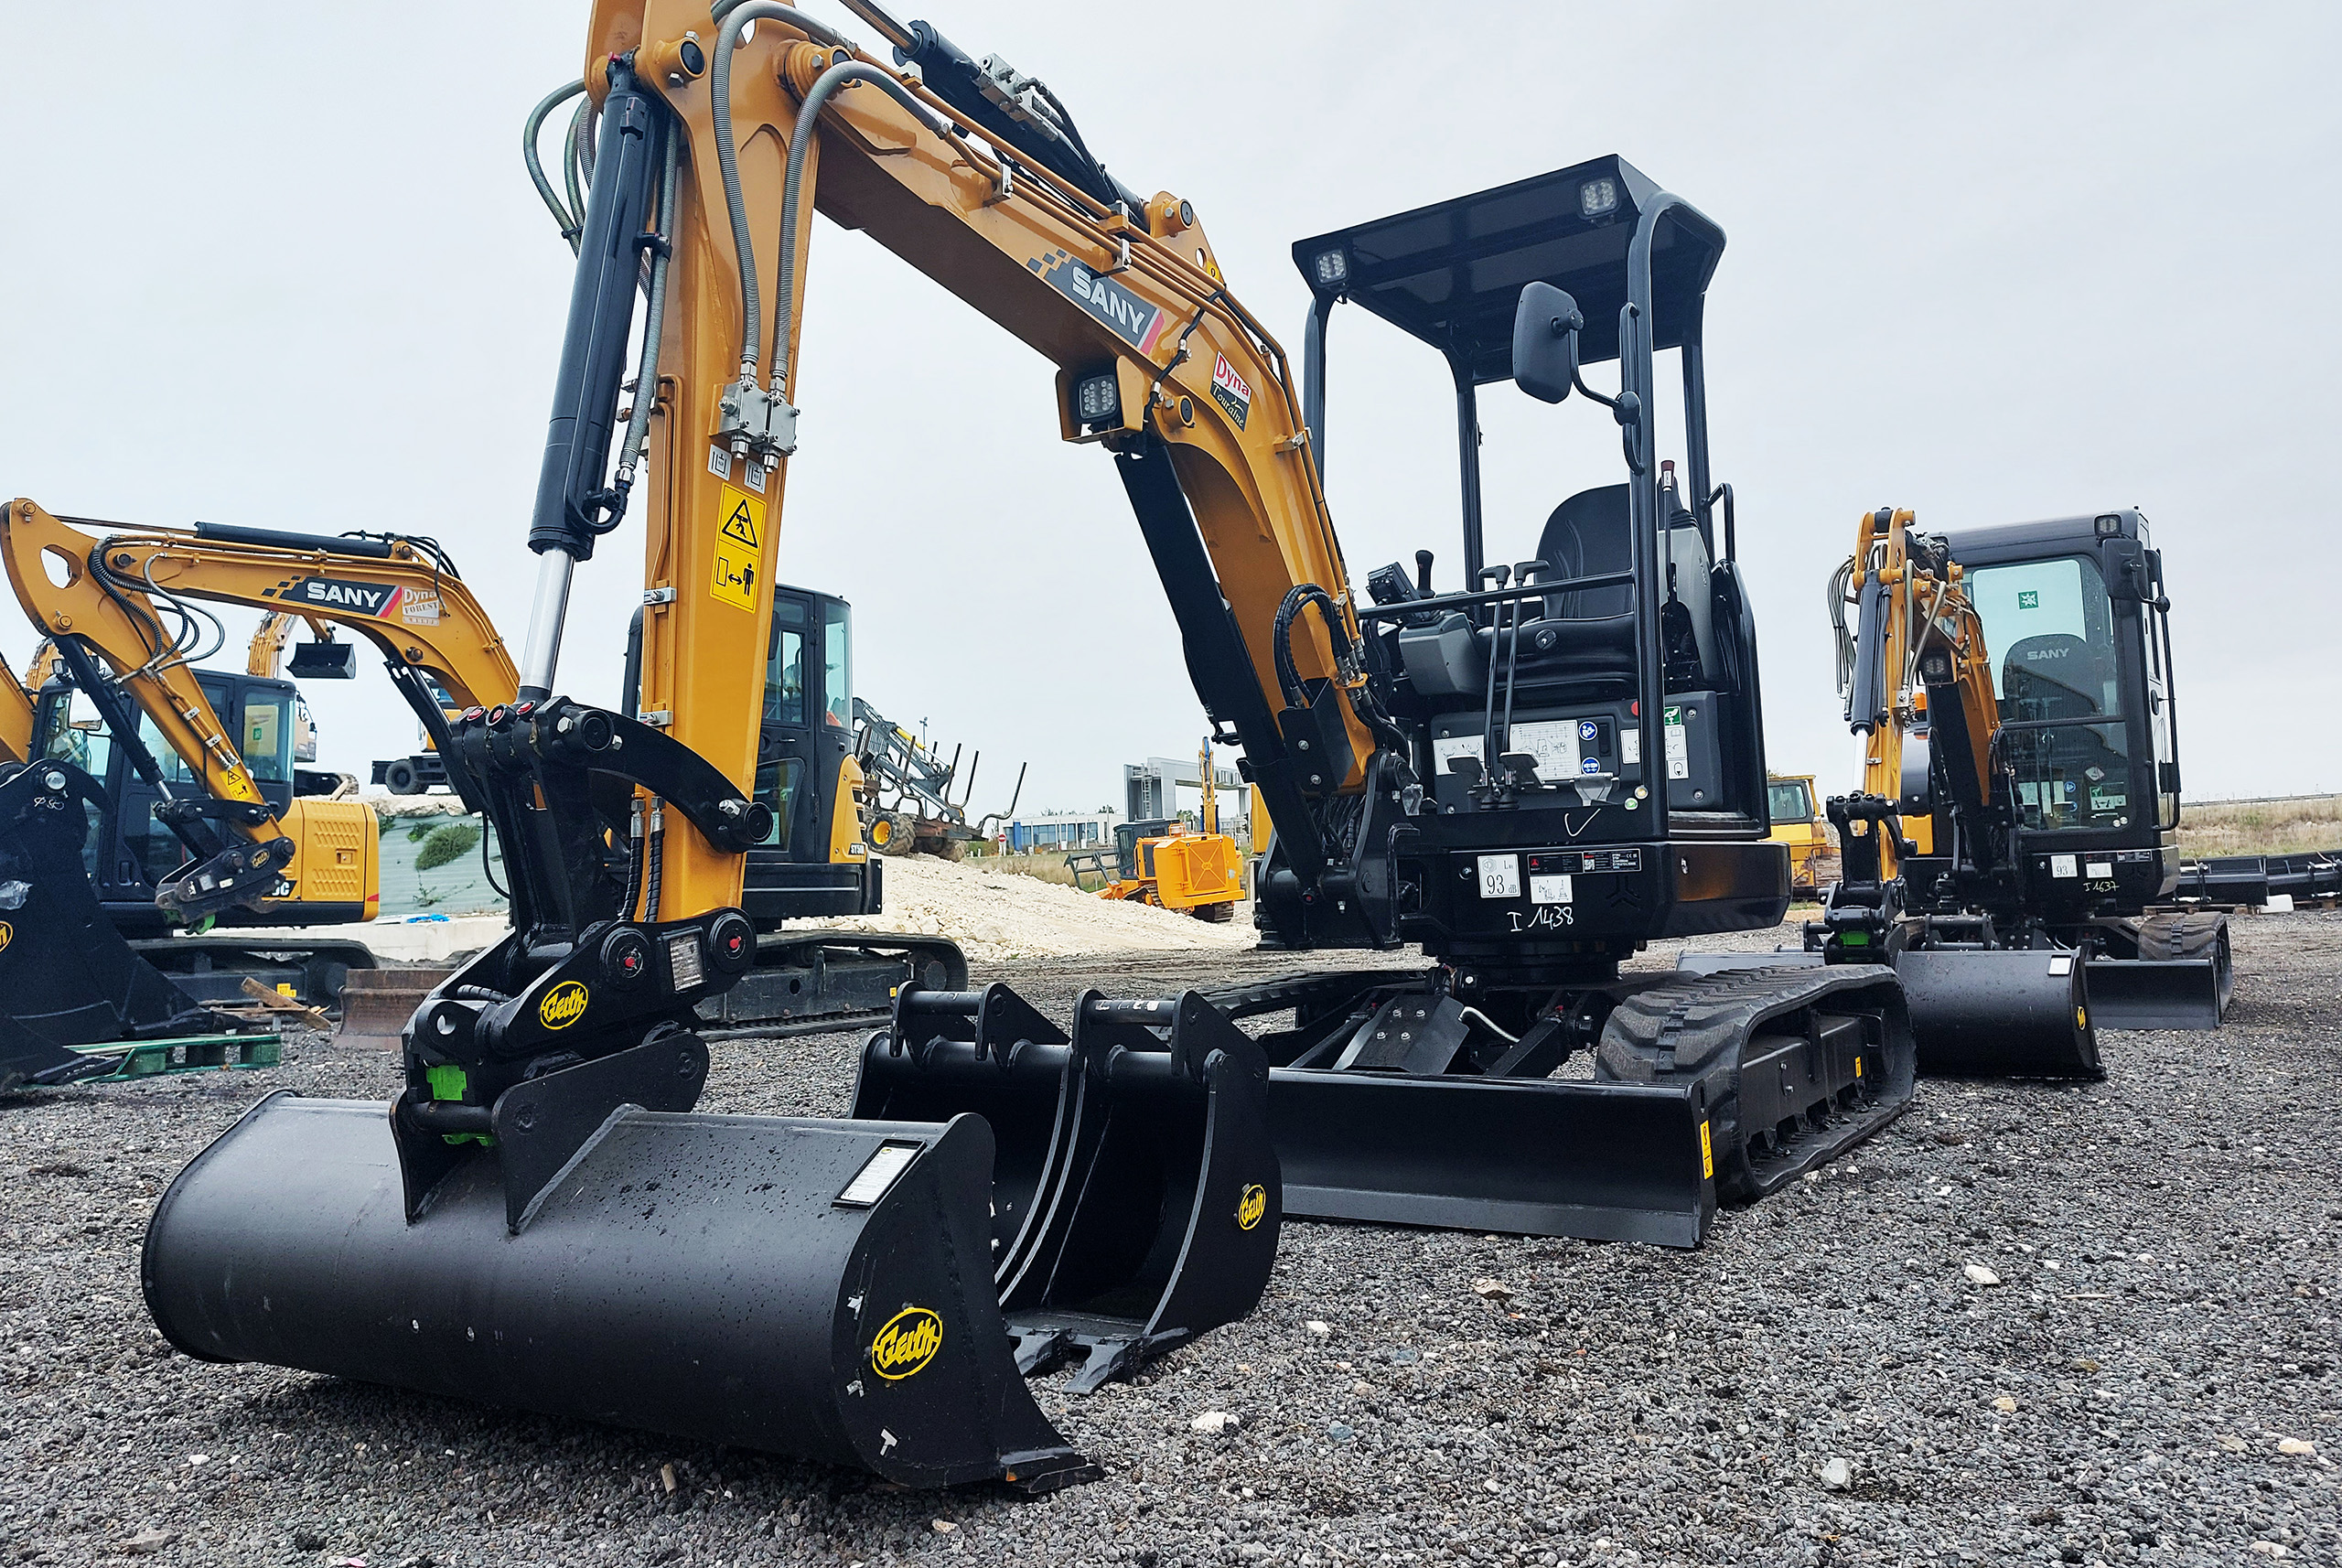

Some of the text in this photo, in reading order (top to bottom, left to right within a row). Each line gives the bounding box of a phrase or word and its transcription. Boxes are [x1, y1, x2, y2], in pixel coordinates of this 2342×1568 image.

[1071, 266, 1145, 335] SANY
[1215, 354, 1250, 397] Dyna
[306, 582, 382, 608] SANY
[403, 588, 437, 605] Dyna
[404, 602, 438, 614] FOREST
[2026, 648, 2070, 660] SANY
[2056, 865, 2068, 876] 93
[1487, 875, 1505, 895] 93
[1528, 906, 1574, 930] 1438
